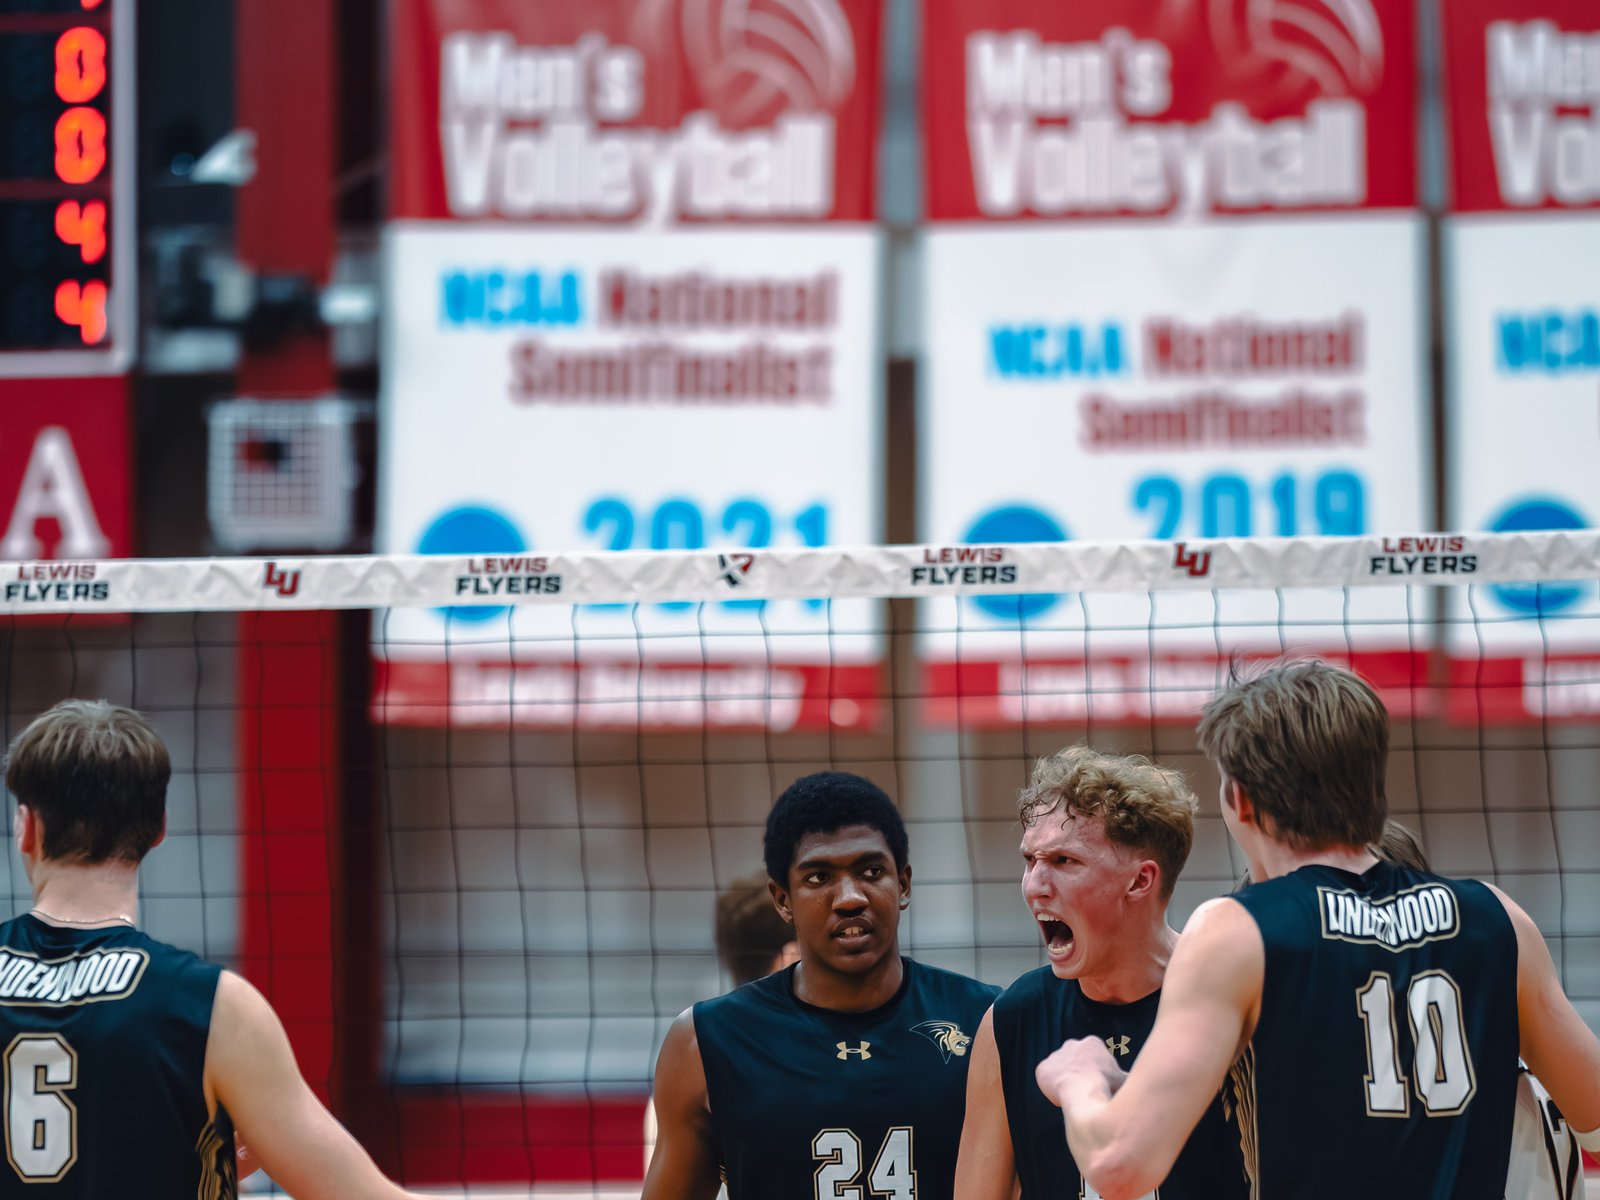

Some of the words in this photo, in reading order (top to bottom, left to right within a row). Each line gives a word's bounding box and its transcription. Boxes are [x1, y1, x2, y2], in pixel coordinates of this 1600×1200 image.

[441, 30, 646, 118] Men's
[966, 28, 1173, 116] Men's
[440, 112, 837, 231] Volleyball
[965, 101, 1366, 223] Volleyball
[54, 200, 106, 264] 4
[54, 280, 107, 345] 4
[439, 268, 582, 331] NCAA
[600, 268, 840, 330] National
[508, 338, 834, 406] Semifinalist
[986, 317, 1128, 378] NCAA
[1141, 312, 1366, 380] National
[1079, 390, 1367, 456] Semifinalist
[1130, 467, 1368, 538] 2019
[17, 563, 97, 581] LEWIS
[467, 557, 549, 575] LEWIS
[911, 565, 1017, 585] FLYERS
[923, 548, 1004, 564] LEWIS
[1370, 555, 1477, 575] FLYERS
[1382, 537, 1464, 554] LEWIS
[5, 582, 109, 602] FLYERS
[455, 575, 562, 596] FLYERS
[1356, 969, 1477, 1118] 10
[3, 1033, 78, 1183] 6
